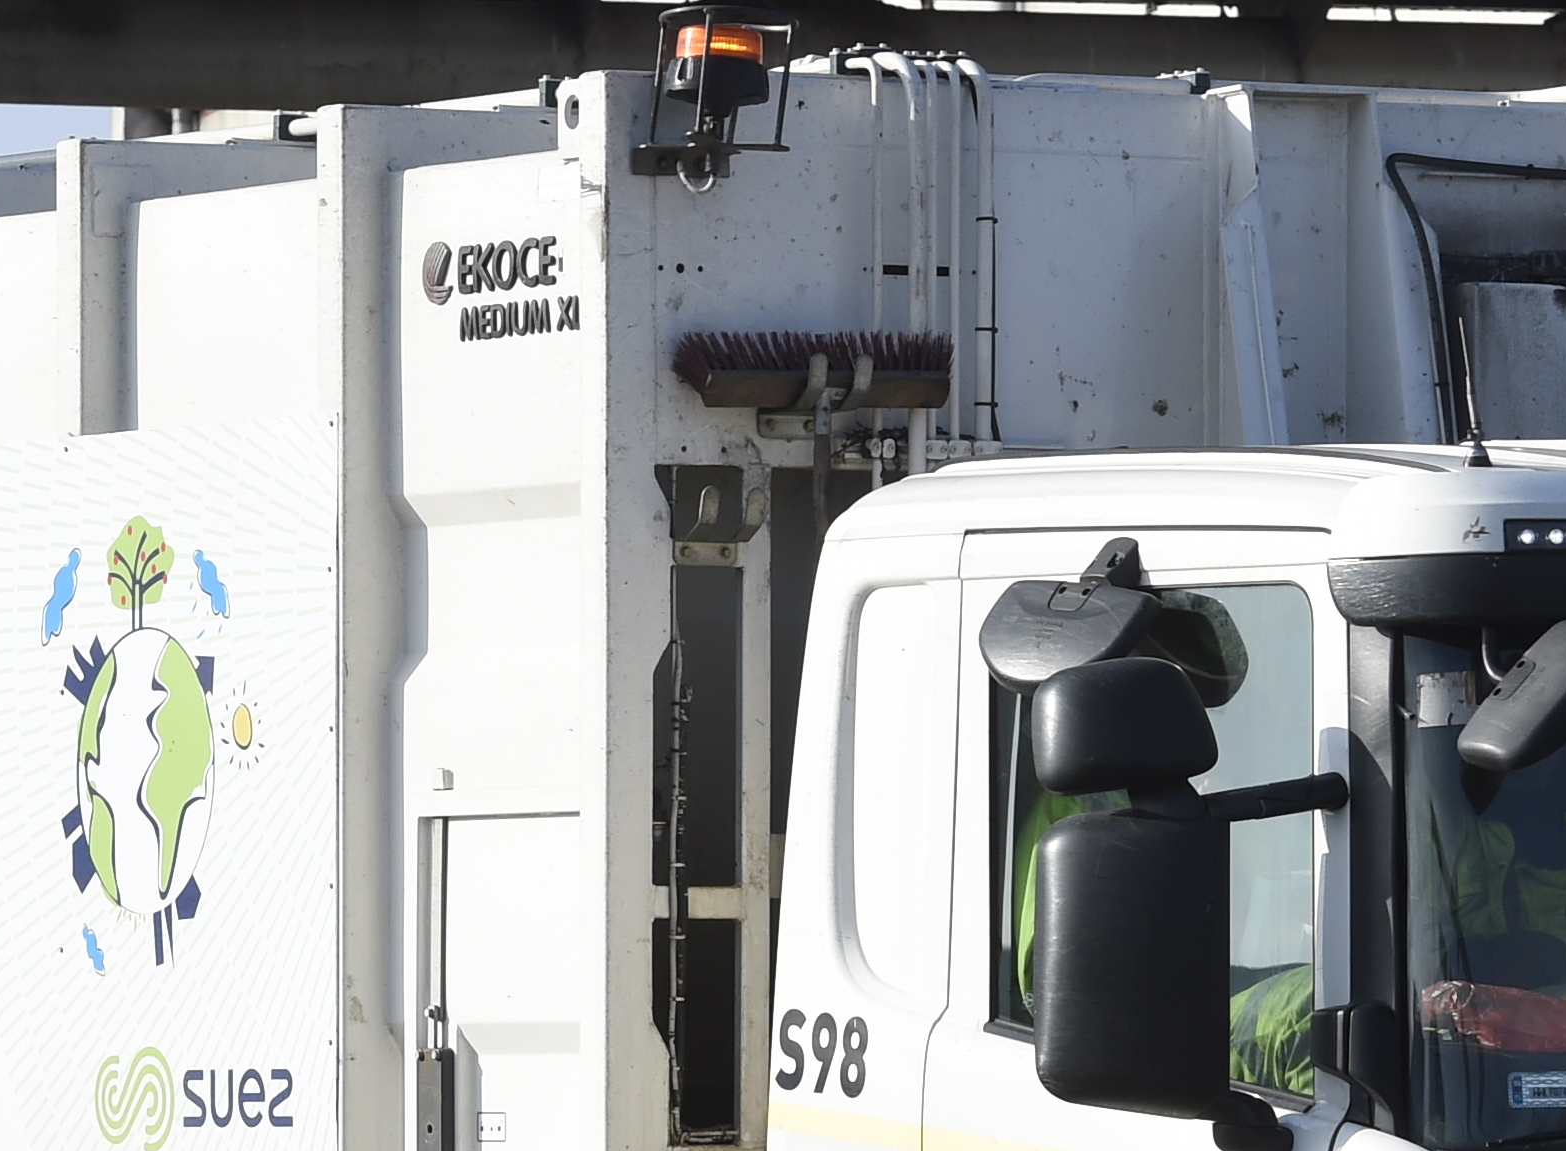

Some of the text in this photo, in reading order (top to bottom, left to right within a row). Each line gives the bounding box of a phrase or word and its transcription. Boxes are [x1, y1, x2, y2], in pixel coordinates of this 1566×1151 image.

[457, 235, 564, 295] EKOCE
[460, 298, 551, 342] MEDIUM
[775, 1008, 868, 1098] S98
[183, 1068, 294, 1128] suez
